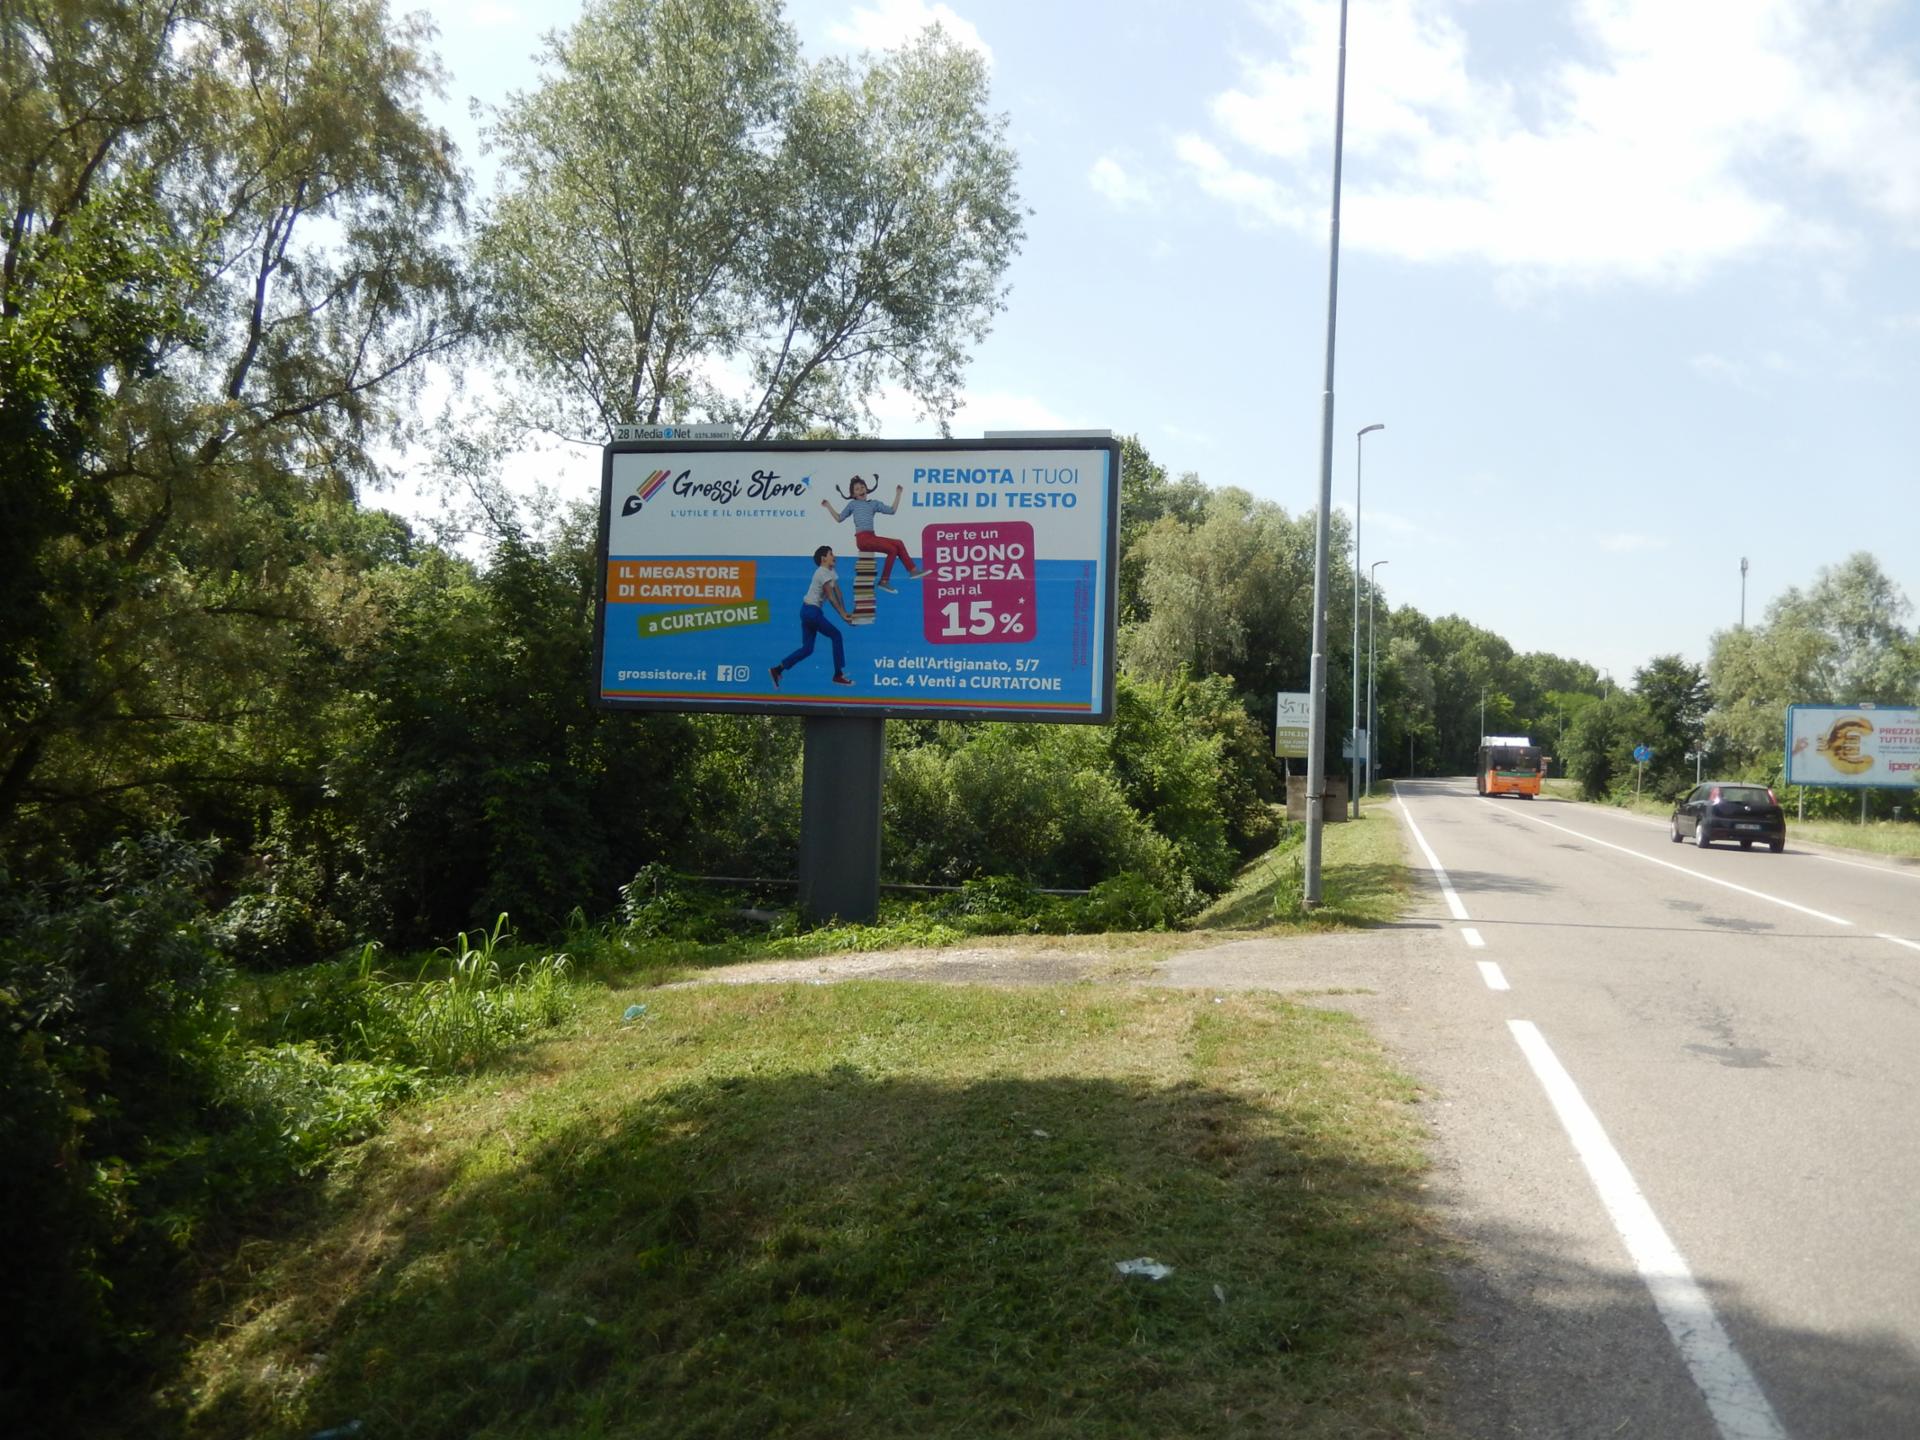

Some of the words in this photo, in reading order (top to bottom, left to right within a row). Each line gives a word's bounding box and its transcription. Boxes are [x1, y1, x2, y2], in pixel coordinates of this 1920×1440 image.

[617, 428, 630, 440] 28
[674, 428, 691, 439] Net
[913, 468, 1015, 484] PRENOTA
[1021, 468, 1026, 484] I
[1032, 468, 1079, 485] TUOI
[672, 469, 742, 504] Grossi
[747, 469, 806, 501] Store
[911, 492, 968, 507] LIBRI
[975, 492, 999, 508] DI
[1005, 492, 1078, 508] TESTO
[671, 509, 710, 518] L'UTILE
[722, 509, 733, 517] IL
[736, 509, 806, 518] DILETTEVOLE
[936, 530, 960, 541] Per
[963, 530, 977, 540] te
[981, 529, 998, 540] un
[936, 543, 1025, 564] BUONO
[619, 567, 634, 579] IL
[639, 567, 740, 580] MEGASTORE
[937, 563, 1025, 582] SPESA
[618, 584, 635, 597] DI
[640, 584, 742, 598] CARTOLERIA
[938, 585, 965, 599] pari
[968, 584, 982, 596] al
[648, 622, 658, 632] a
[661, 606, 759, 631] CURTATONE
[874, 658, 895, 669] via
[898, 657, 1012, 673] dell'Artigianato,
[1015, 659, 1040, 672] 5/7
[618, 668, 707, 681] grossistore.it
[874, 674, 902, 687] Loc.
[906, 675, 916, 687] 4
[919, 675, 956, 688] Venti
[958, 679, 967, 689] a
[970, 676, 1062, 691] CURTATONE
[1879, 727, 1914, 735] PREZZI
